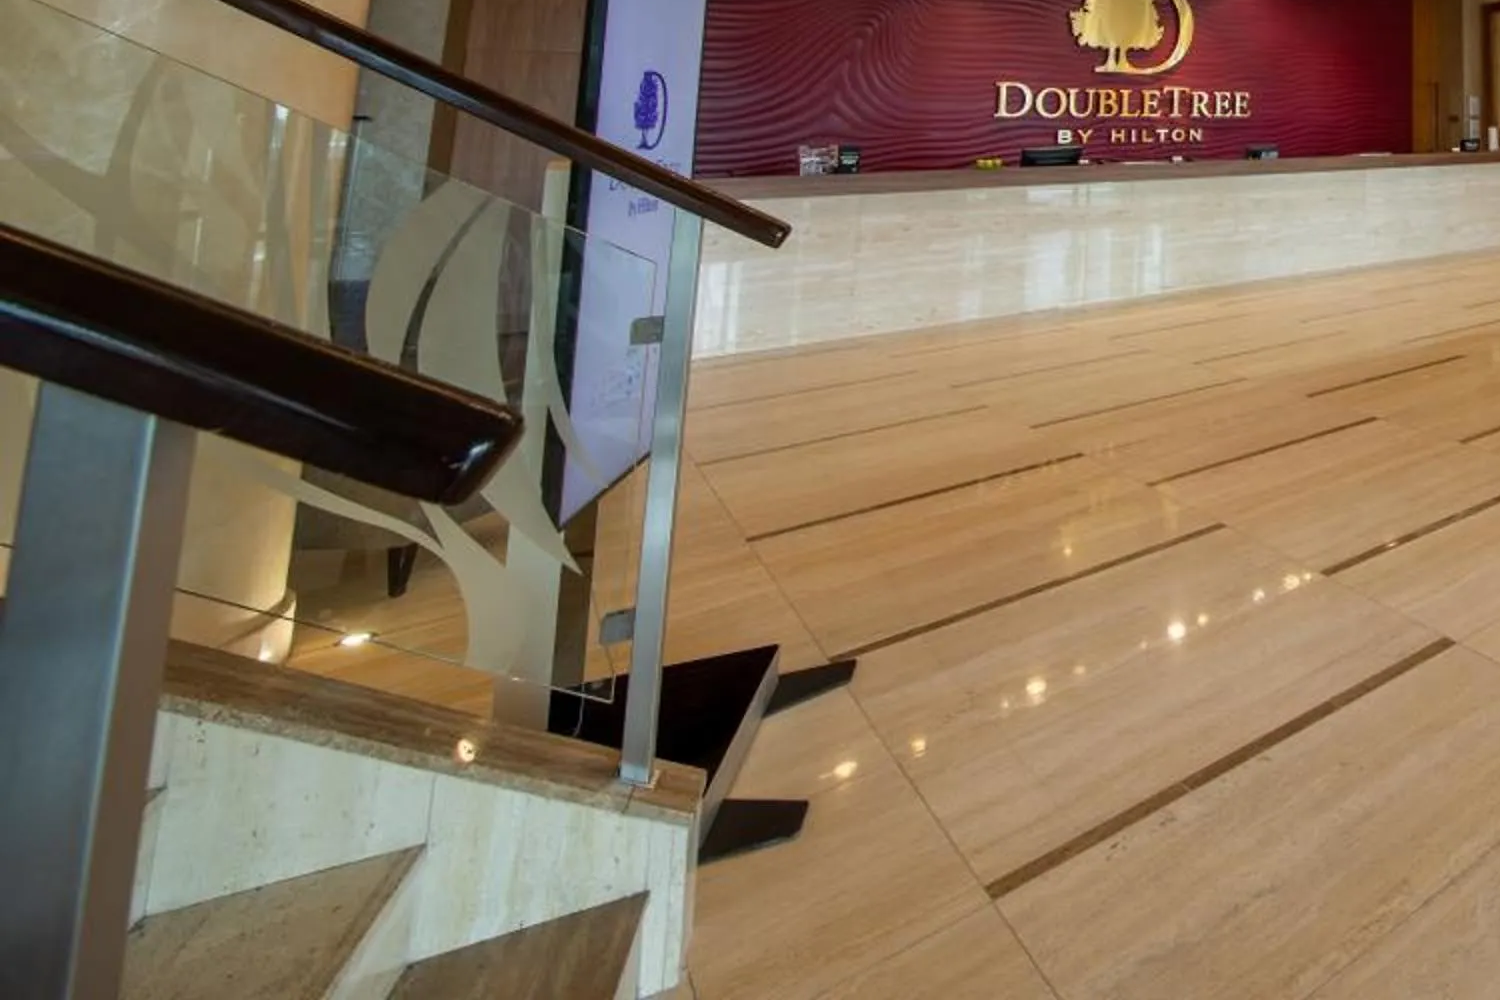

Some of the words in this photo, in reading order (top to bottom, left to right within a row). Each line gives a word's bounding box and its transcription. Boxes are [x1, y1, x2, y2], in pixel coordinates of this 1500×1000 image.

[994, 81, 1251, 118] DOUBLETREE
[1057, 129, 1094, 144] BY
[1111, 129, 1202, 143] HILTON
